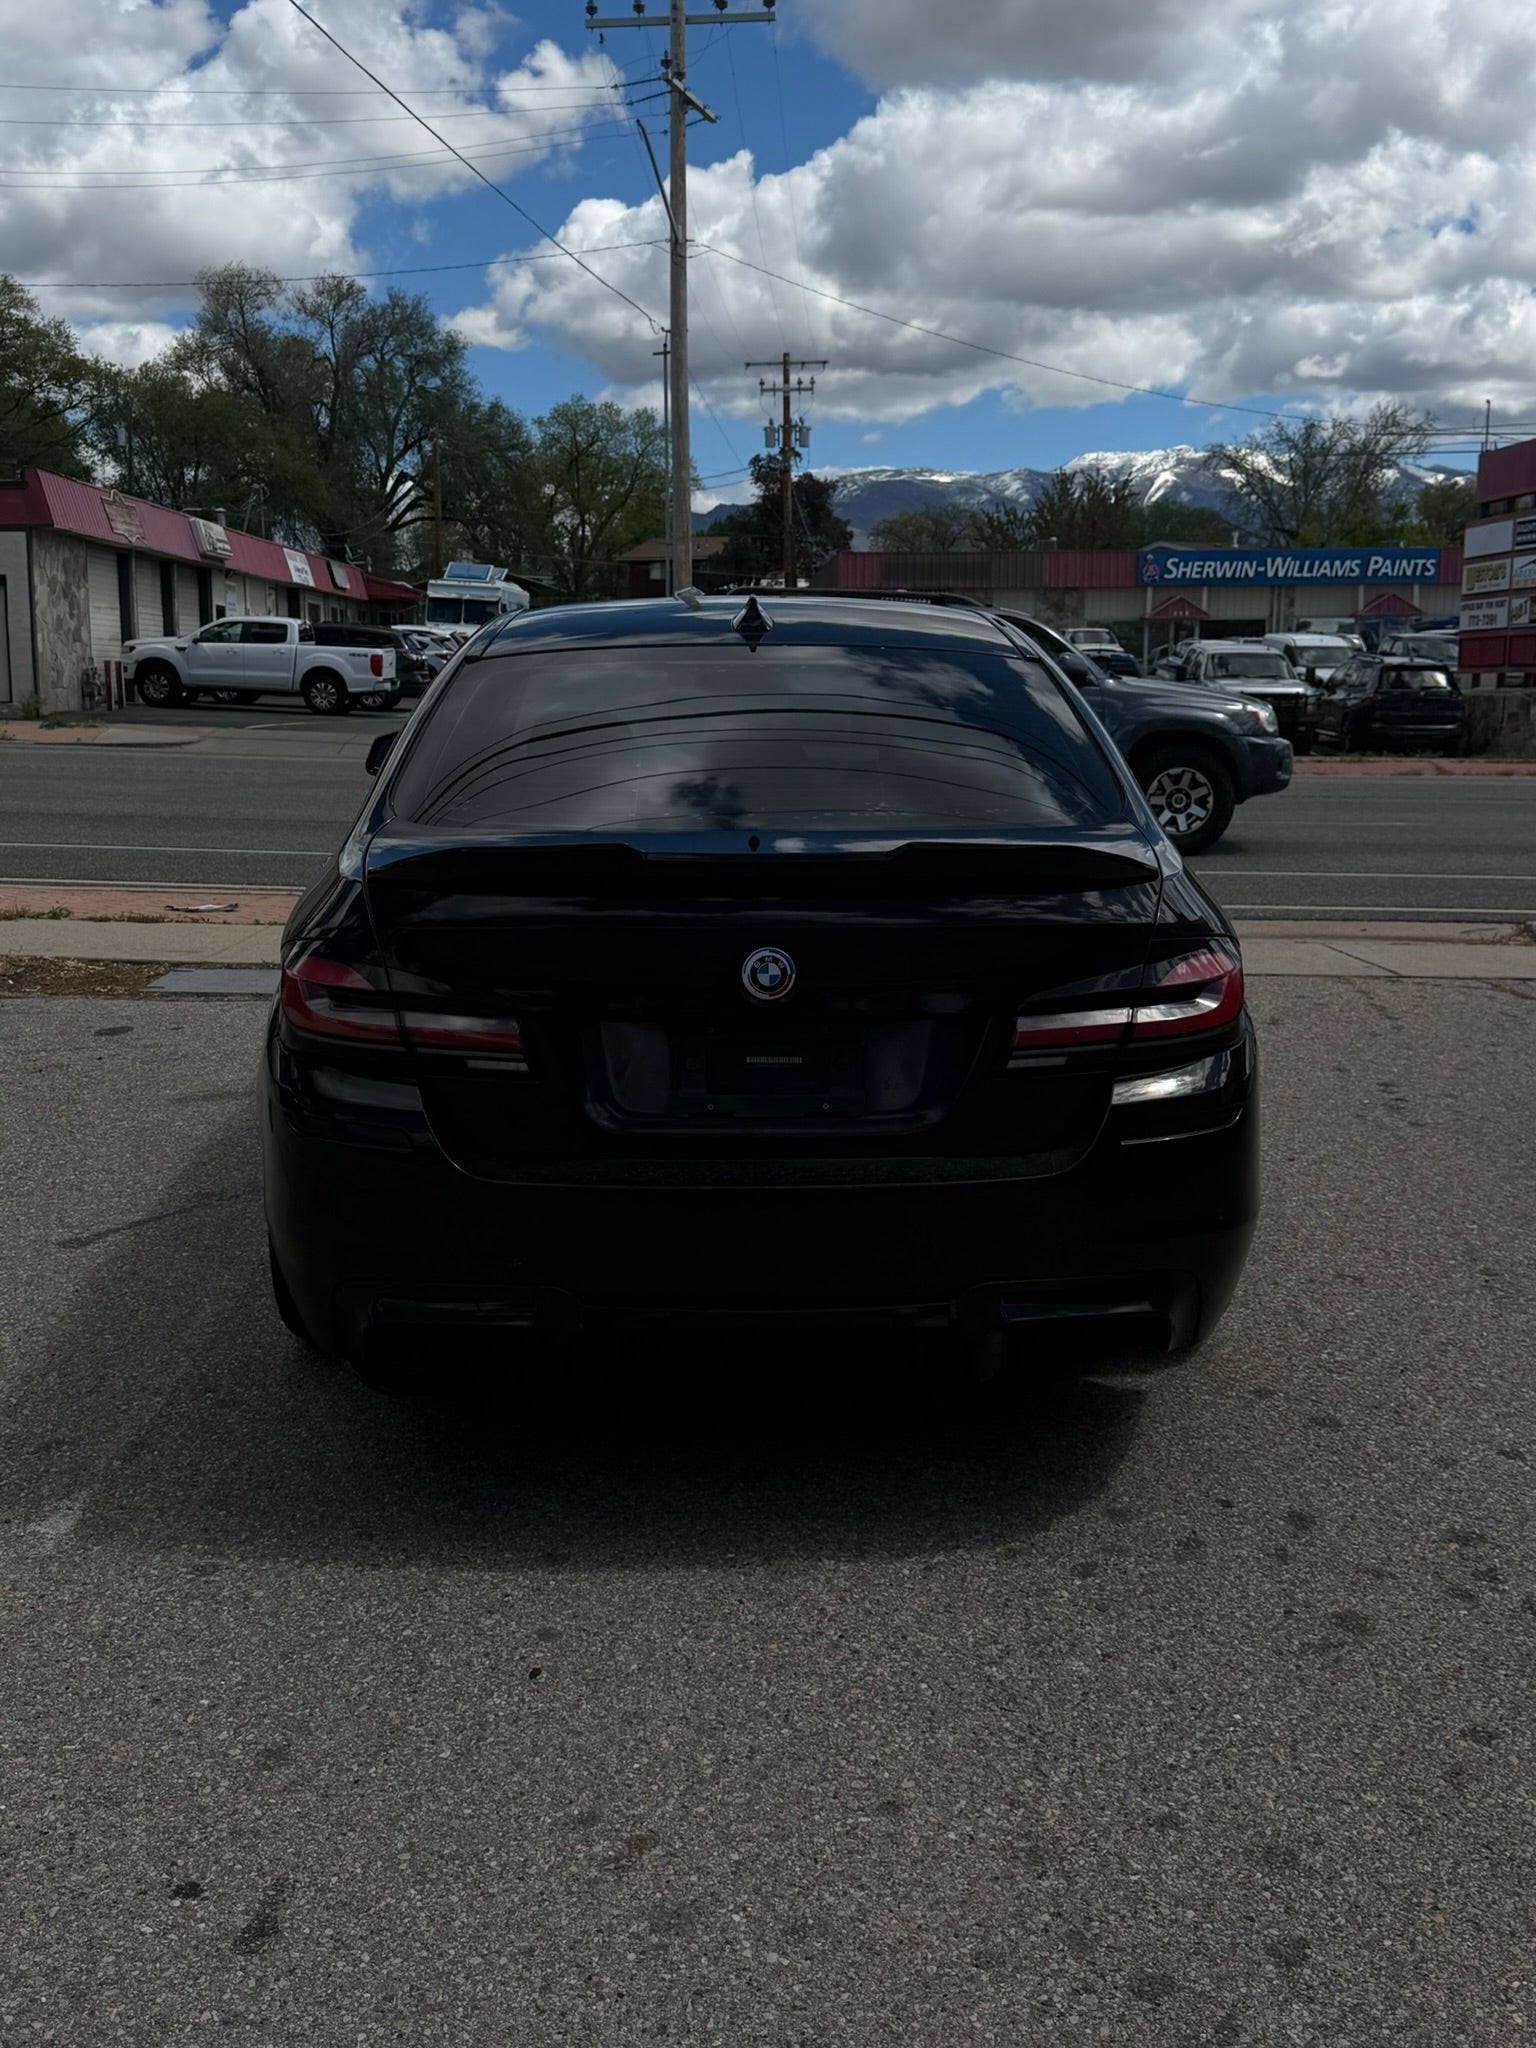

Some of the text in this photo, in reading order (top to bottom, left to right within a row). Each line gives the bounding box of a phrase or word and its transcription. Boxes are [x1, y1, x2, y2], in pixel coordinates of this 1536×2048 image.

[1164, 556, 1437, 580] SHERWIN-WILLIAMS PAINTS
[754, 956, 785, 969] BMW
